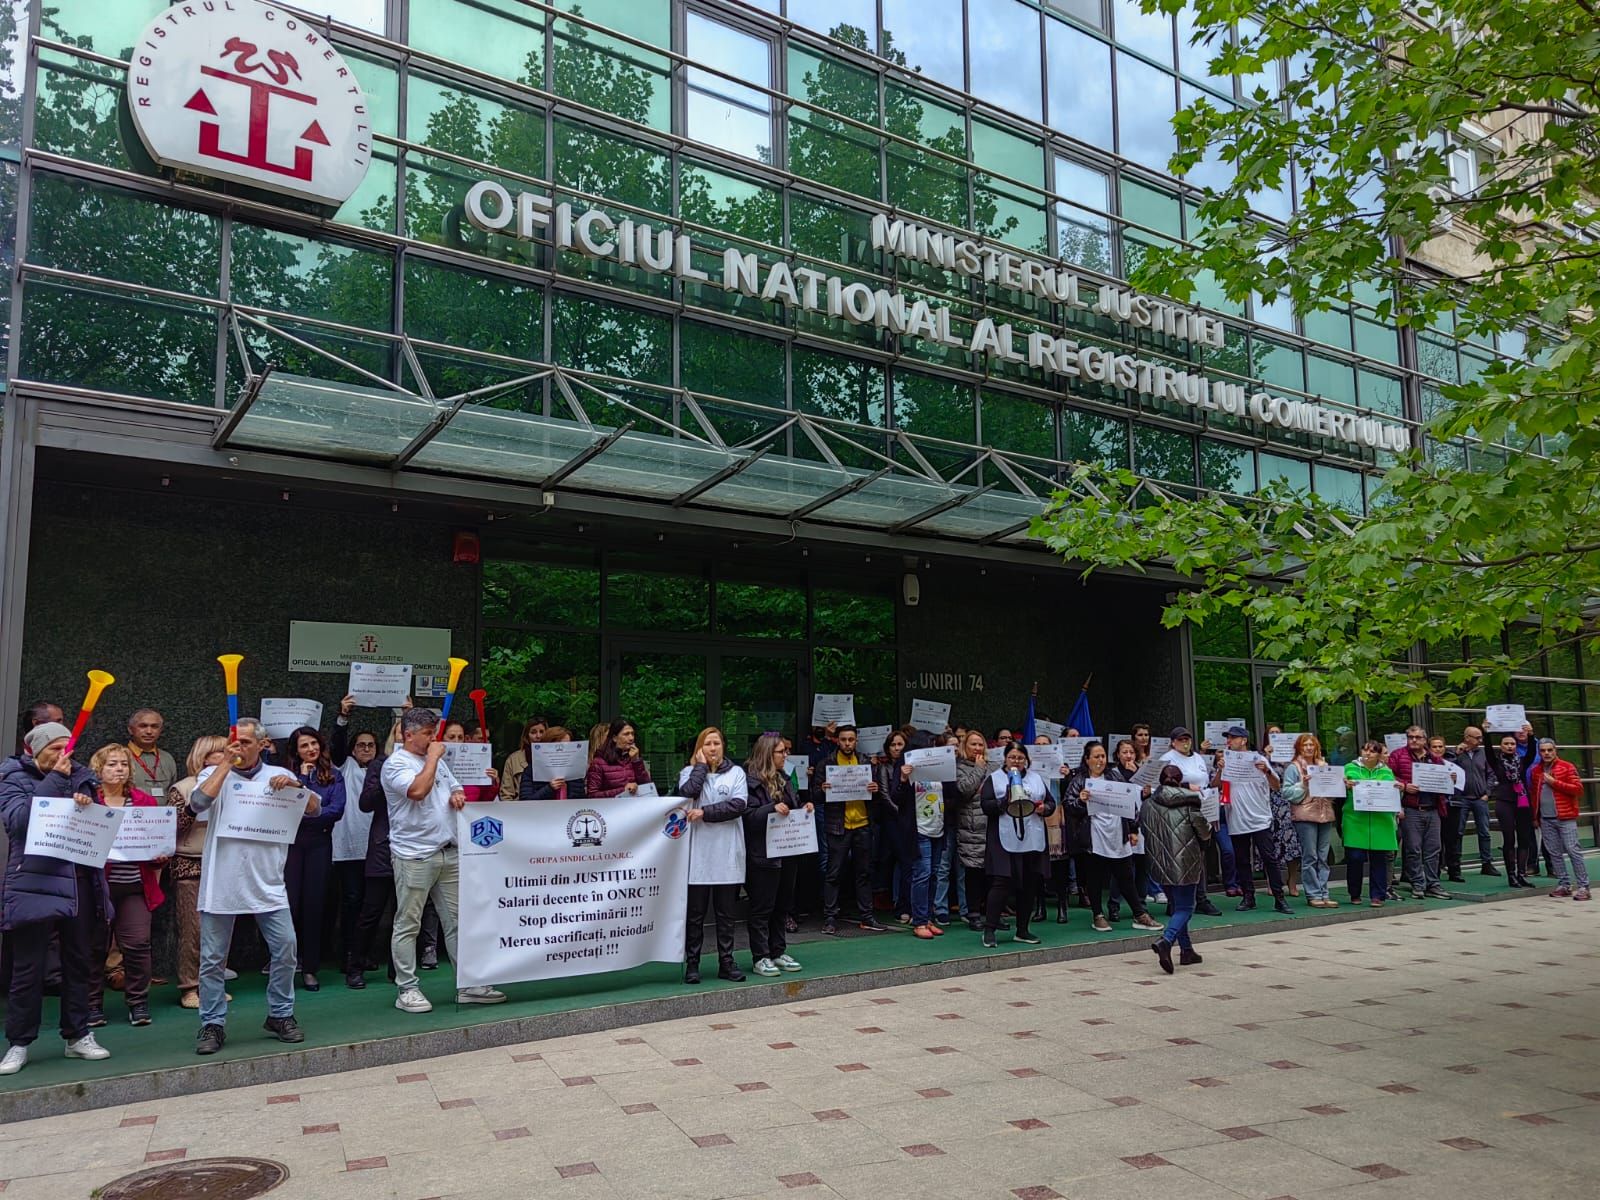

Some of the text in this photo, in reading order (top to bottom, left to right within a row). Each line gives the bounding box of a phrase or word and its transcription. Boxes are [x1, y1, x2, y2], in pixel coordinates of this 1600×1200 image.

[136, 1, 368, 165] REGISTRUL COMERTULUI
[871, 213, 1225, 349] MINISTERUL JUSTITIEI
[464, 180, 1411, 452] OFICIUL NATIONAL AL REGISTRULUI COMERTULUI
[320, 660, 350, 668] NATIONA
[920, 672, 961, 691] UNIRII
[968, 674, 984, 692] 74
[529, 855, 558, 865] GRUPA
[504, 867, 657, 889] Ultimii din JUSTIȚIE !!!!
[498, 885, 660, 909] Salarii decente în ONRC !!!
[519, 905, 643, 929] Stop discriminării !!!
[500, 920, 654, 949] Mereu sacrificați, niciodată
[546, 943, 619, 963] respectați !!!
